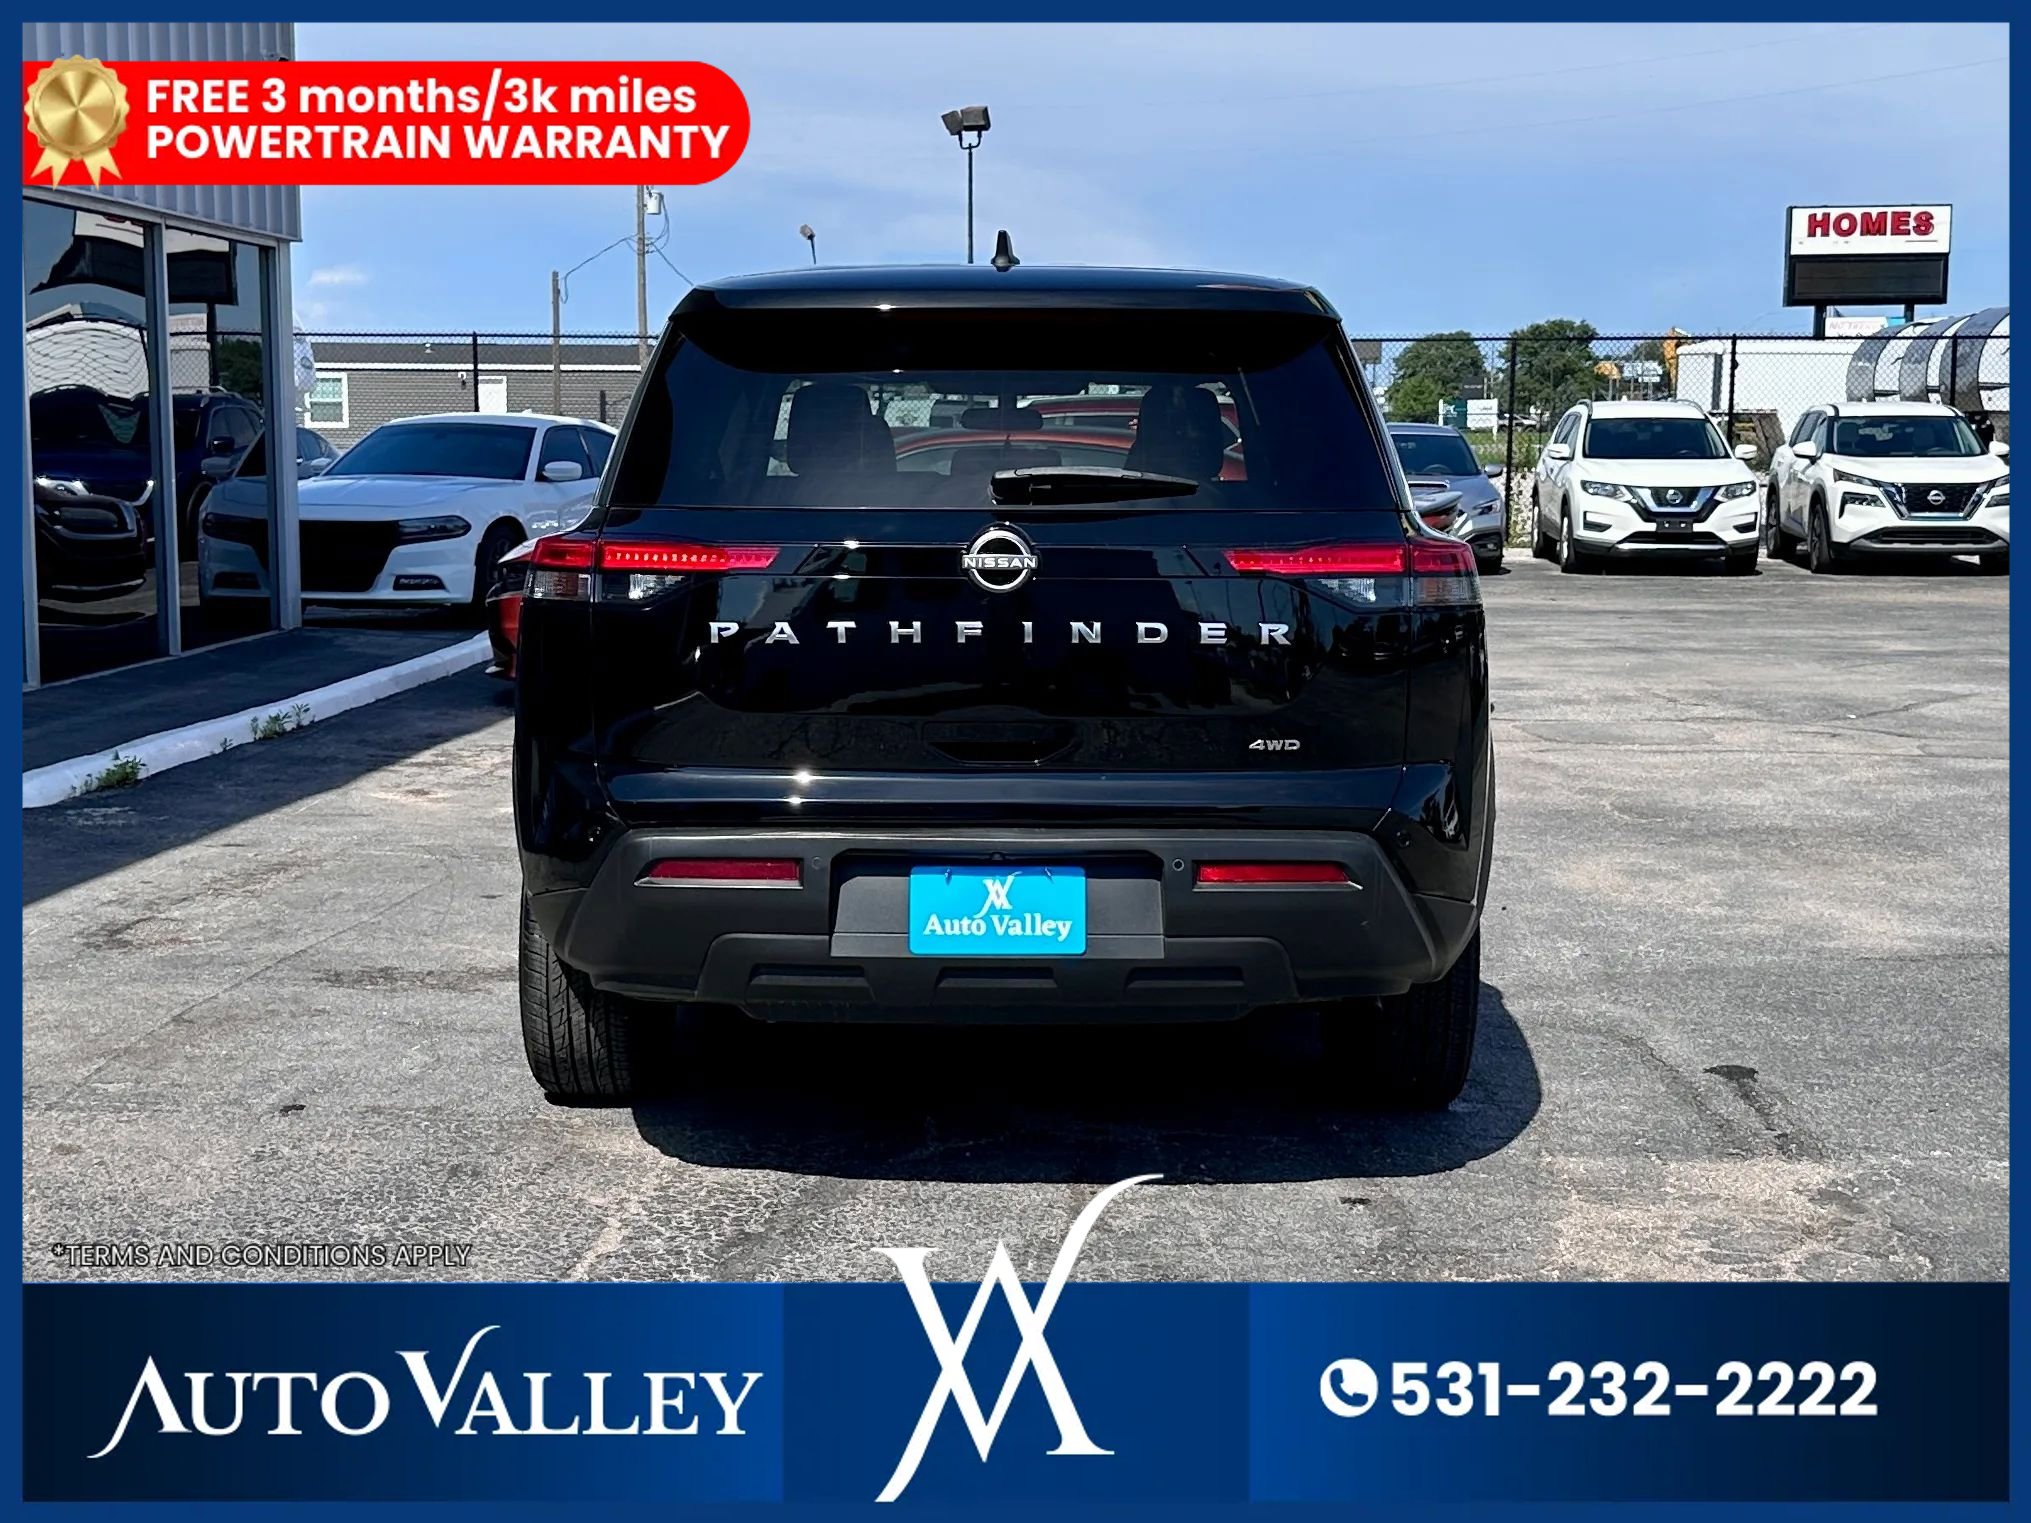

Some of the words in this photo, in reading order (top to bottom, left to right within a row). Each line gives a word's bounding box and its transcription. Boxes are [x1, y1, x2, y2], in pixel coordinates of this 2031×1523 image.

[1807, 211, 1934, 238] HOMES
[963, 557, 1036, 569] NISSAN
[708, 620, 1291, 645] PATHFINDER
[1248, 738, 1301, 751] 4WD
[923, 913, 987, 936] Auto
[990, 912, 1073, 942] Valley
